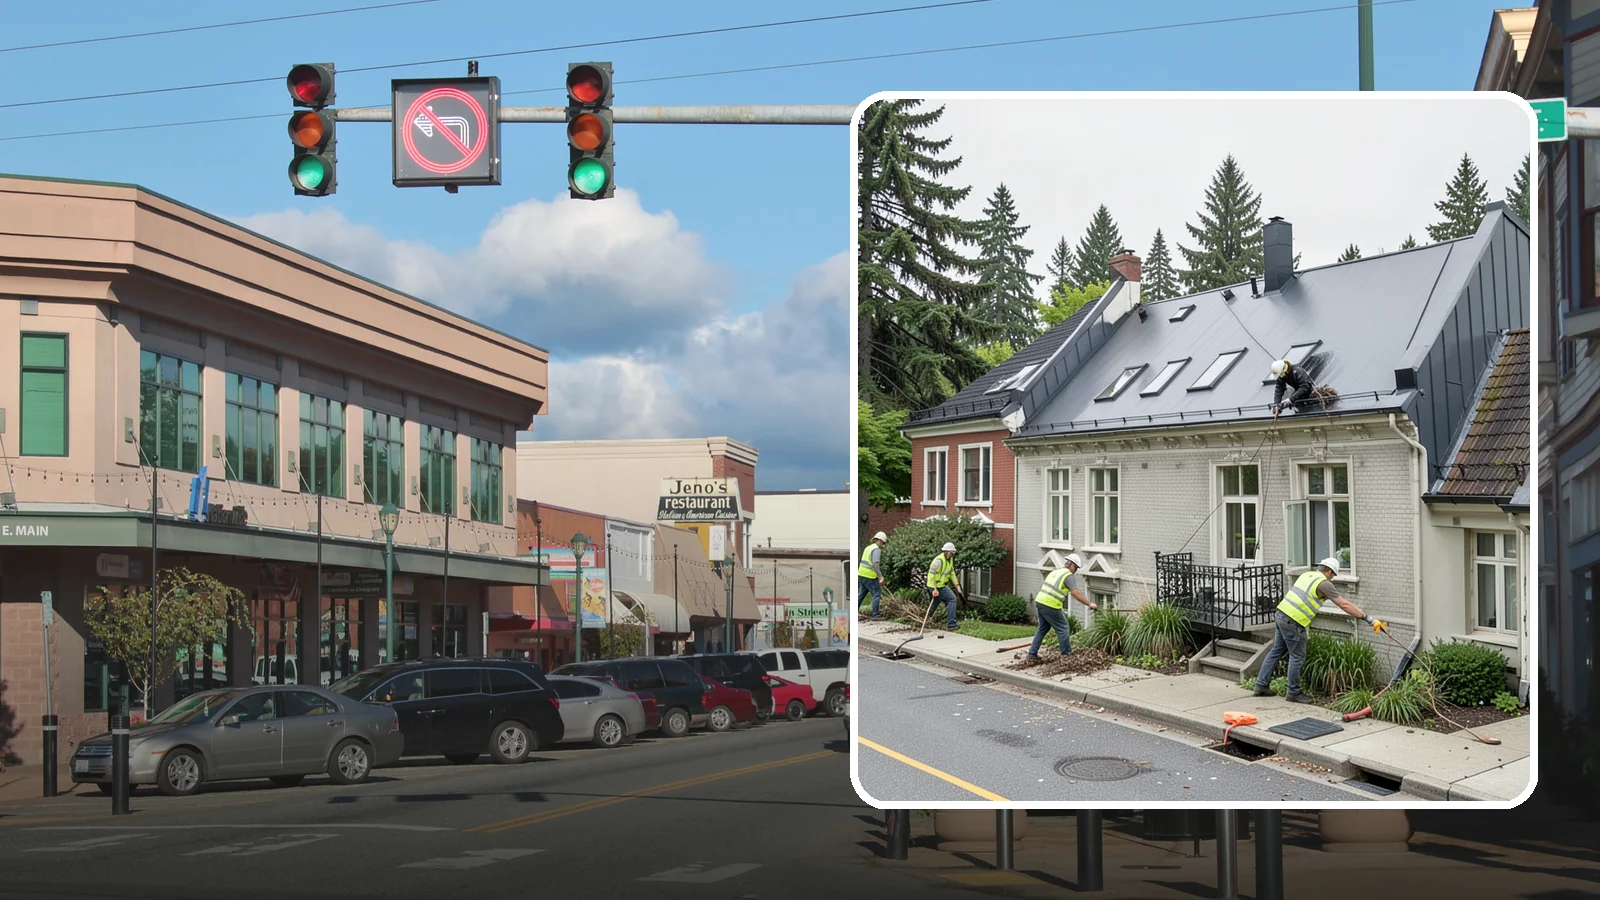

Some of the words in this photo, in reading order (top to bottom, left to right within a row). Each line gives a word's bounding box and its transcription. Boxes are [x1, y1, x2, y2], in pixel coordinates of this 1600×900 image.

[669, 480, 728, 495] Jeno's
[665, 496, 731, 509] restaurant
[686, 509, 715, 519] American
[715, 509, 738, 519] Cuisine
[2, 525, 13, 536] E.
[15, 525, 49, 536] MAIN
[797, 607, 828, 617] Street
